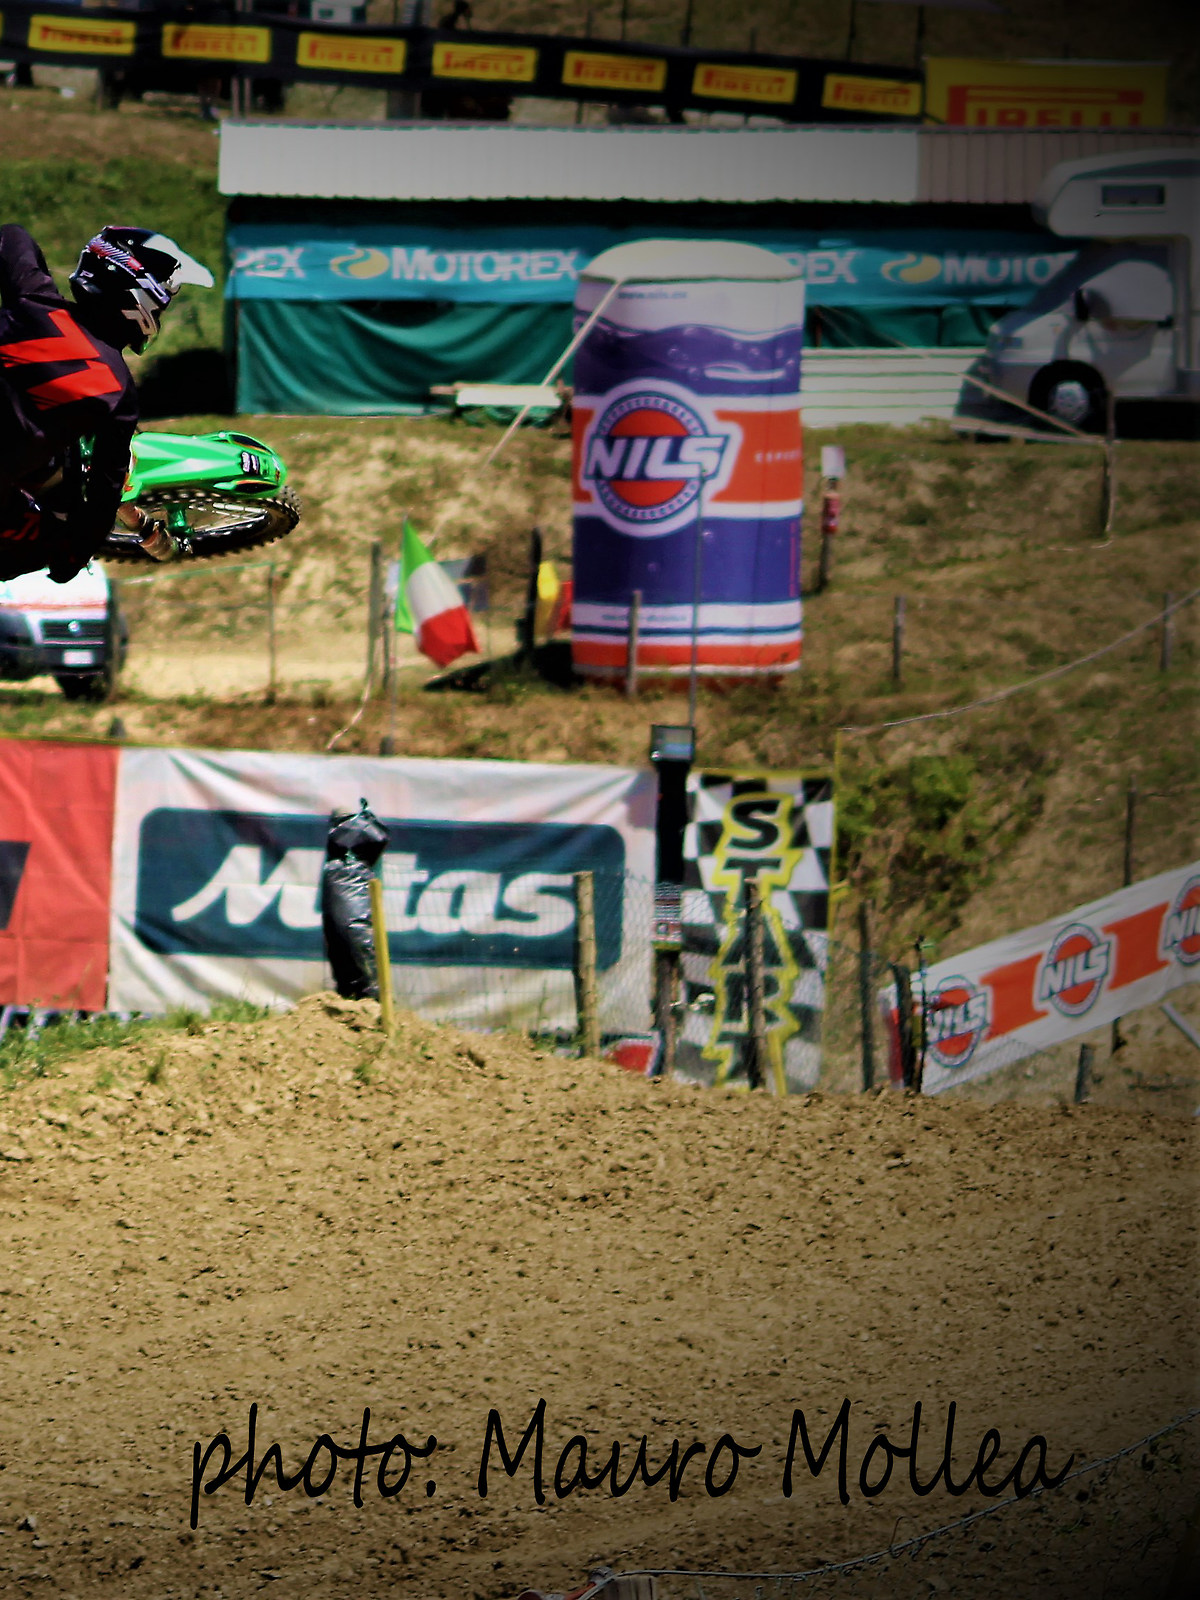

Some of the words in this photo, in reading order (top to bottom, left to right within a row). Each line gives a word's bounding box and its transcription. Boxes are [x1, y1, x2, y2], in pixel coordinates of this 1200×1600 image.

[171, 29, 258, 55] PIRELLI
[308, 39, 393, 66] PIRELLI
[443, 50, 526, 76] PIRELLI
[574, 59, 654, 83] PIRELLI
[703, 69, 786, 95] PIRELLI
[833, 81, 911, 108] PIRELLI
[391, 247, 582, 282] MOTOREX
[587, 437, 728, 479] NILS
[171, 845, 576, 937] Mtas
[1040, 941, 1111, 1001] NILS
